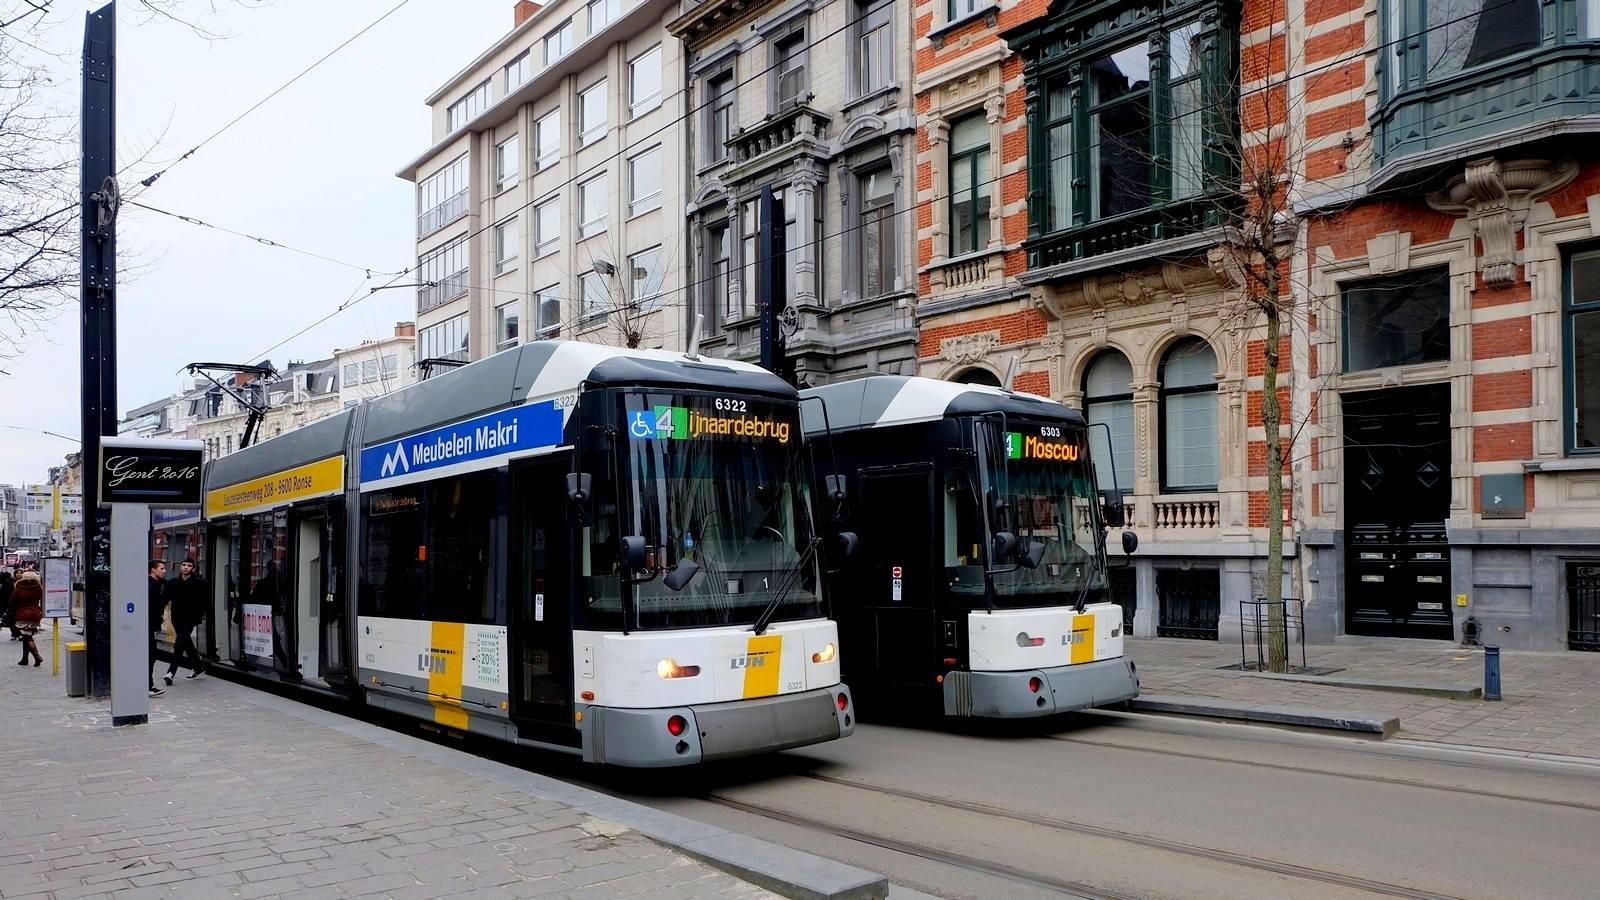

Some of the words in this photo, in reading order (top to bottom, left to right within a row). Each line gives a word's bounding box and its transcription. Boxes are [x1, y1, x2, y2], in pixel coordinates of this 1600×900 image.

[555, 395, 575, 408] 6322
[715, 398, 747, 413] 6322
[655, 407, 675, 438] 4
[689, 411, 789, 443] ijnaardebrug
[1041, 426, 1061, 438] 6303
[413, 432, 472, 466] Meubelen
[475, 418, 518, 452] Makri
[1025, 436, 1078, 461] Moscou
[105, 455, 159, 487] Gent
[159, 466, 199, 479] 2016
[263, 482, 274, 498] 208
[278, 477, 293, 495] 9600
[293, 475, 313, 491] Ronse
[1075, 567, 1081, 577] 5
[763, 577, 769, 590] 1
[787, 681, 804, 691] 6322
